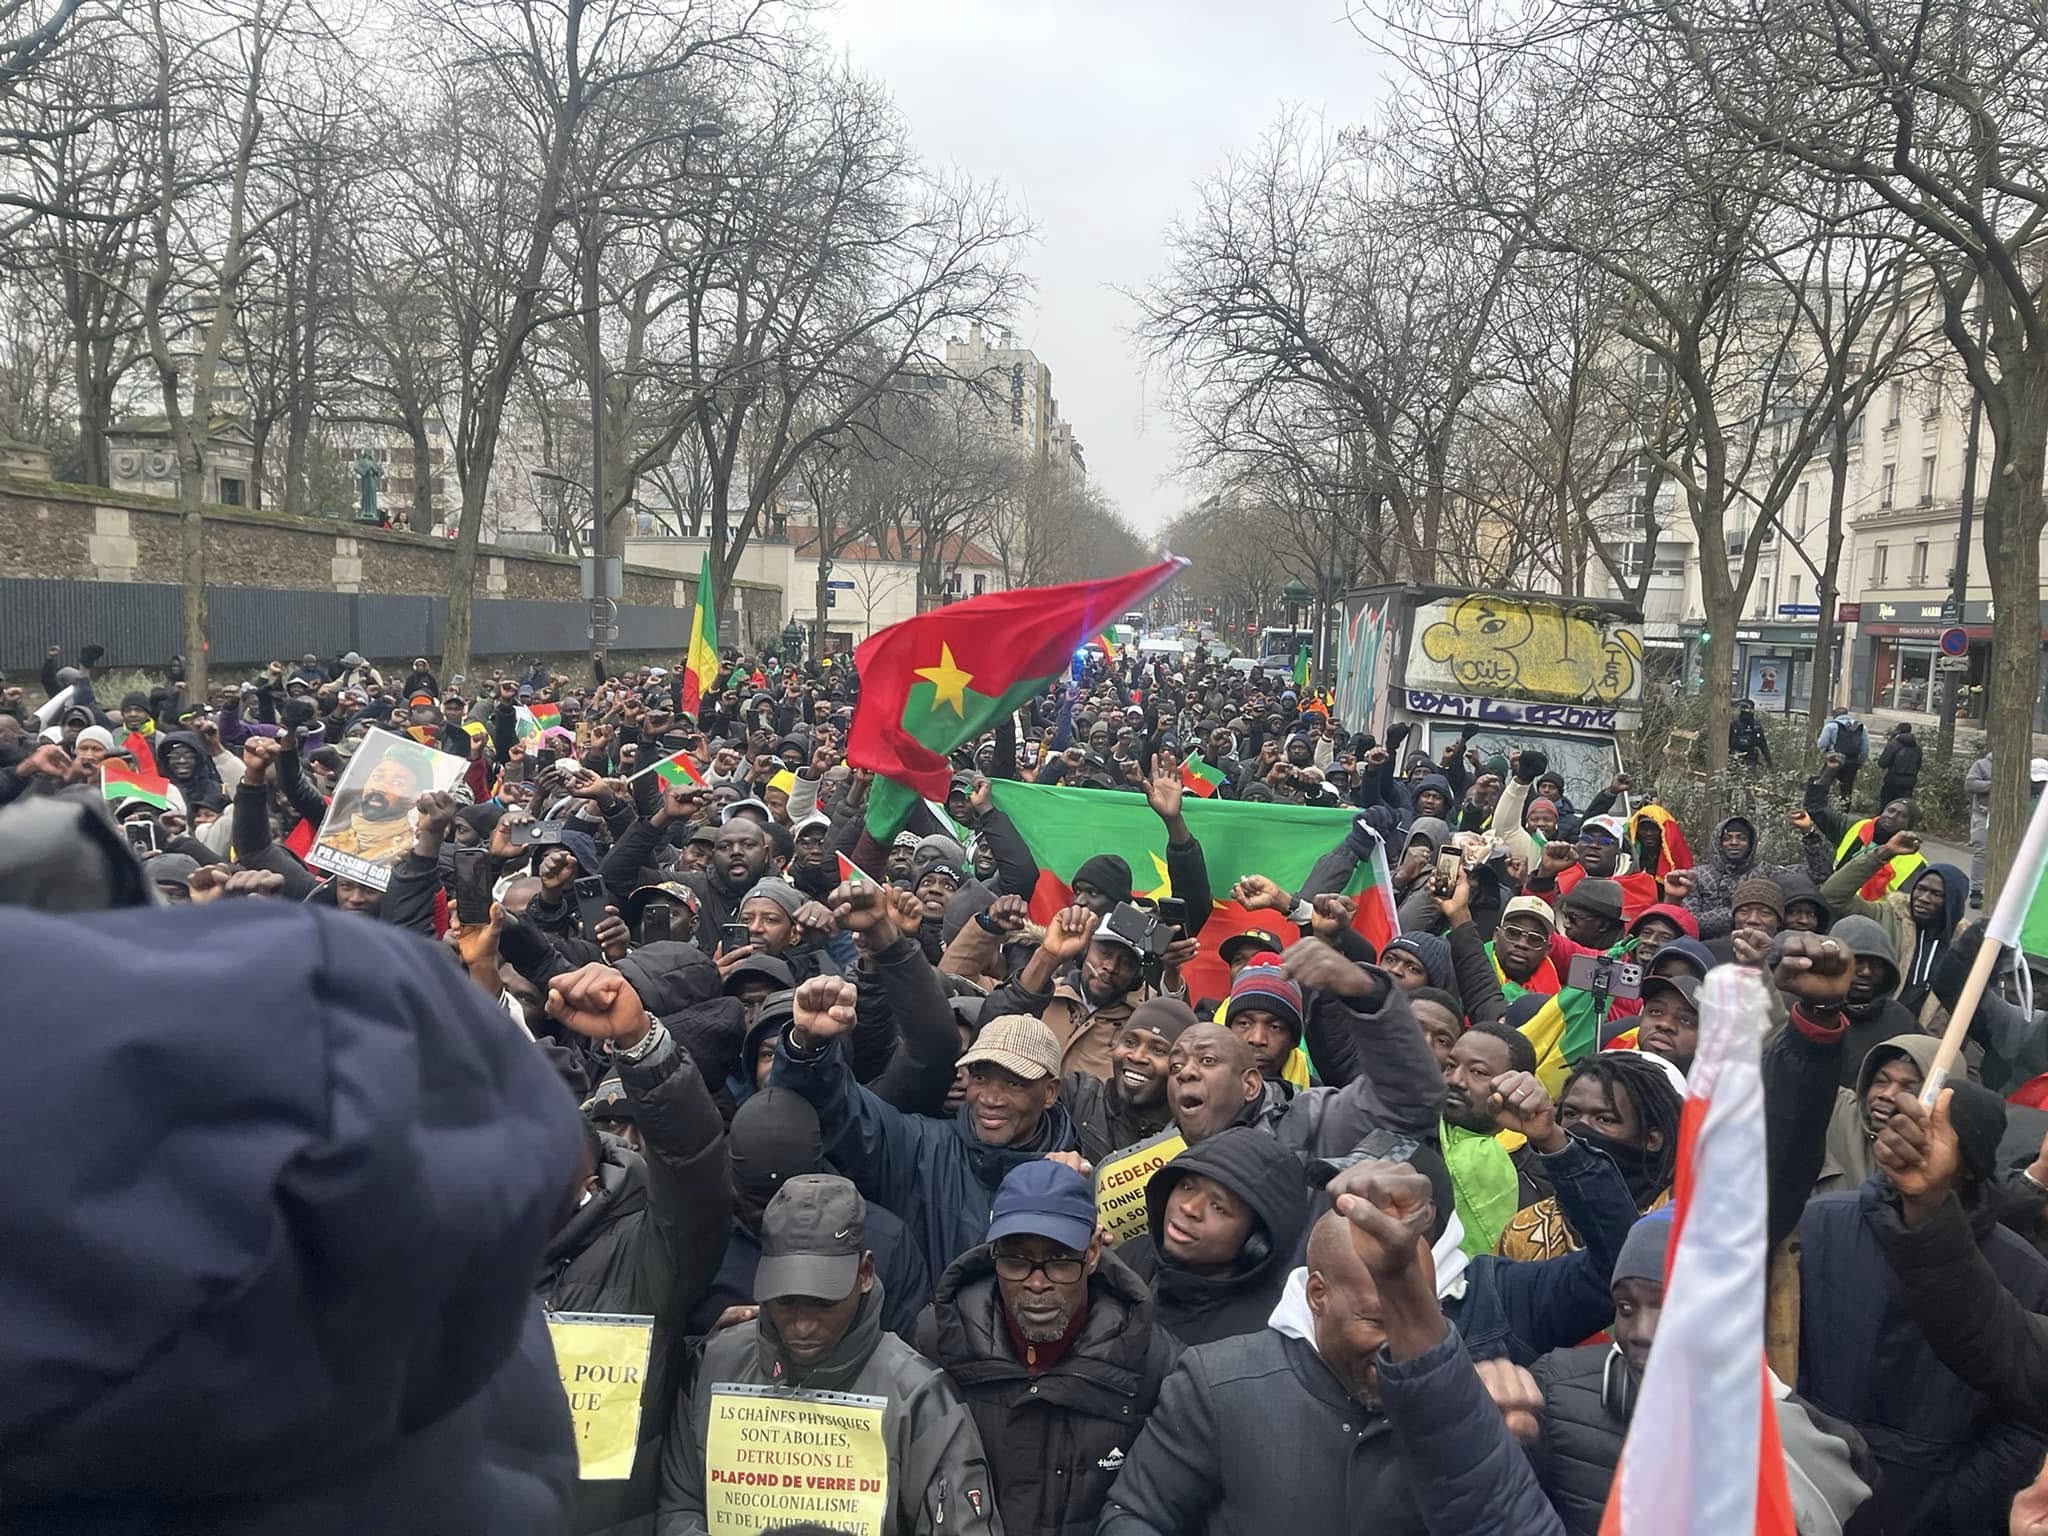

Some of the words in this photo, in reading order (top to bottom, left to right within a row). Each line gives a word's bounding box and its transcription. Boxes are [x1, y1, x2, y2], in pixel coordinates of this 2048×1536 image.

[316, 845, 334, 860] PR
[332, 850, 370, 874] ASSIMI
[1107, 1156, 1165, 1189] CEDEAO
[1102, 1188, 1144, 1212] TONNE
[1108, 1216, 1126, 1230] LA
[1126, 1205, 1148, 1221] SO
[575, 1364, 638, 1385] POUR
[570, 1392, 601, 1412] UE
[720, 1406, 735, 1420] LS
[737, 1407, 796, 1424] CHAÎNES
[799, 1412, 871, 1432] PHYSIQUES
[741, 1428, 780, 1443] SONT
[783, 1431, 851, 1449] ABOLIES,
[736, 1449, 832, 1467] DETRUISONS
[836, 1455, 854, 1469] LE
[711, 1469, 779, 1487] PLAFOND
[782, 1475, 802, 1489] DE
[806, 1476, 856, 1491] VERRE
[859, 1479, 881, 1493] DU
[724, 1491, 859, 1513] NEOCOLONIALISME
[716, 1511, 733, 1524] ET
[735, 1513, 751, 1527] DE
